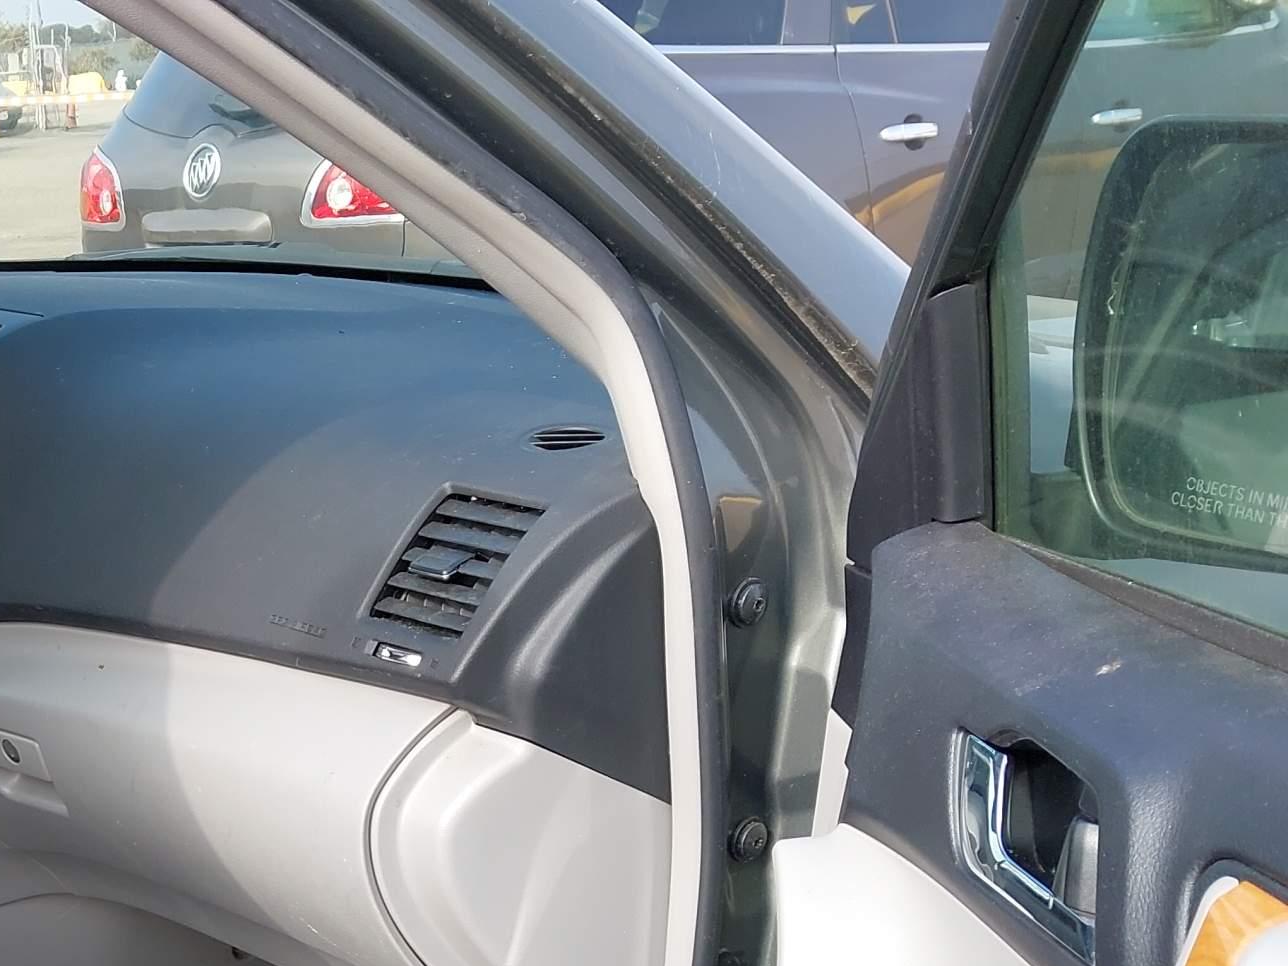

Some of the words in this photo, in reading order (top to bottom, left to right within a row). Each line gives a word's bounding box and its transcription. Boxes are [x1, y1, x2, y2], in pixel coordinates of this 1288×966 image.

[1186, 476, 1246, 501] OBJECTS
[1248, 489, 1265, 505] IN
[1171, 491, 1223, 515] CLOSER
[1227, 503, 1265, 524] THAN
